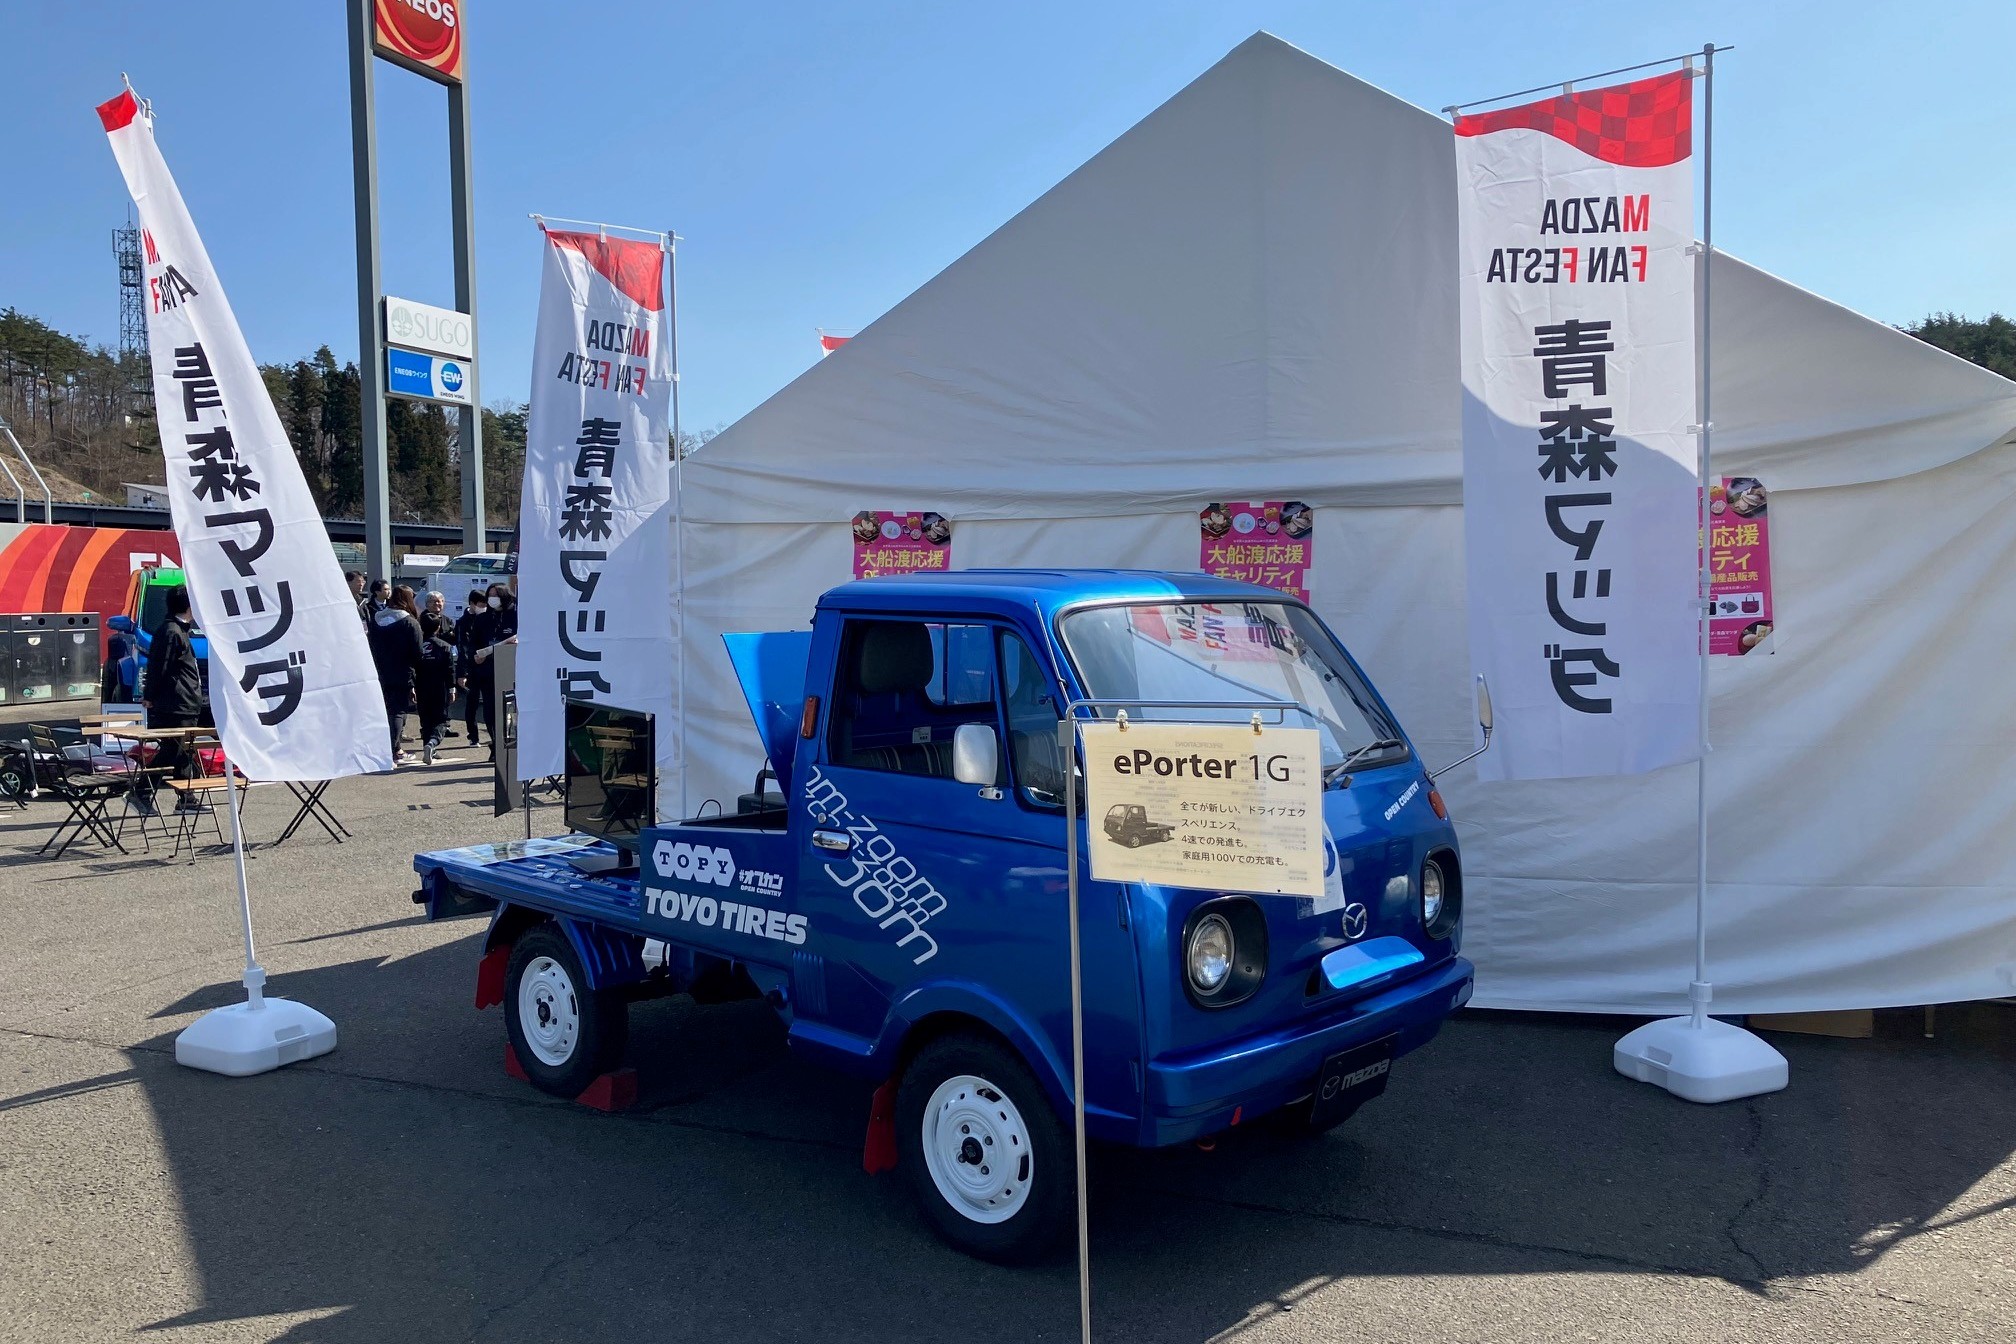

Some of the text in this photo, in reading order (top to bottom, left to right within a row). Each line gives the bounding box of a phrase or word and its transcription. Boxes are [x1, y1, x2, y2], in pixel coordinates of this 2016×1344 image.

[414, 312, 469, 347] SUGO
[1698, 523, 1760, 548] 応援
[860, 549, 944, 568] 大船渡応援
[1207, 544, 1304, 565] 大船渡応援
[1113, 749, 1238, 780] ePorter
[1249, 753, 1291, 783] 1G
[1179, 800, 1307, 818] 全てが新しい、ドライブエク
[1384, 780, 1420, 821] OPEN COUNTRY
[1181, 834, 1248, 849] 4速での発進も。
[659, 851, 729, 875] TOPY
[1182, 850, 1289, 867] 家庭用100Vでの充電も。
[740, 884, 782, 897] OPEN COUNTRY
[645, 887, 808, 945] TOYO TIRES
